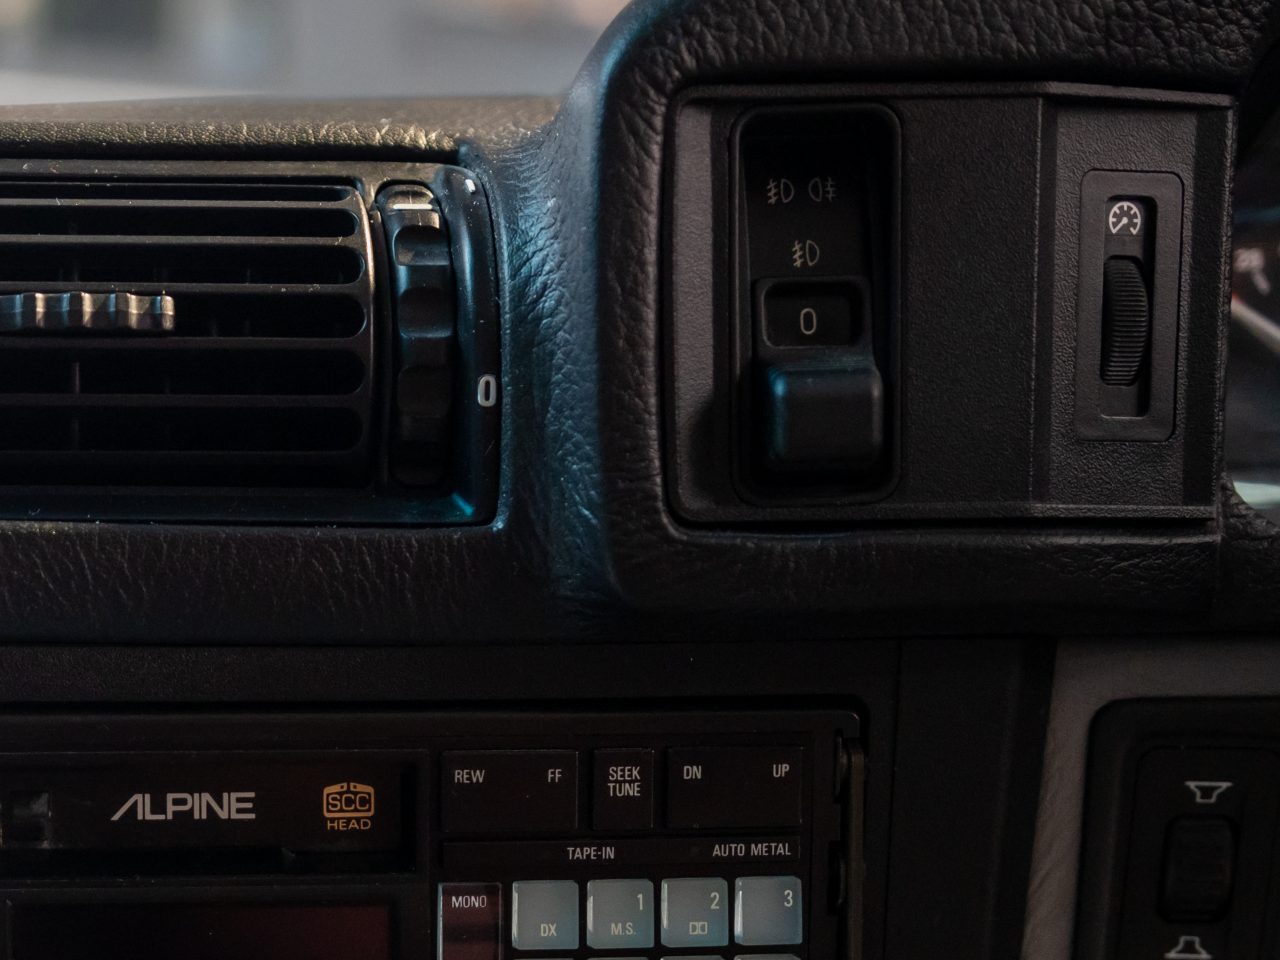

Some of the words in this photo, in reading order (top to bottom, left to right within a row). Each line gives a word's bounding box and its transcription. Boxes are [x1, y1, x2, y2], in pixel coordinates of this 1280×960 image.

[800, 307, 818, 335] 0
[454, 769, 485, 784] REW
[547, 768, 562, 783] FF
[608, 765, 641, 781] SEEK
[772, 763, 790, 779] UP
[607, 782, 641, 797] TUNE
[110, 791, 257, 822] ALPINE
[327, 793, 370, 812] SCC
[326, 818, 372, 831] HEAD
[567, 846, 615, 860] TAPE-IN
[712, 843, 745, 858] AUTO
[750, 842, 791, 857] METAL
[451, 895, 487, 909] MONO
[635, 893, 644, 911] 1
[709, 892, 720, 910] 2
[783, 889, 794, 907] 3
[540, 923, 557, 937] DX
[610, 922, 636, 936] M.S.
